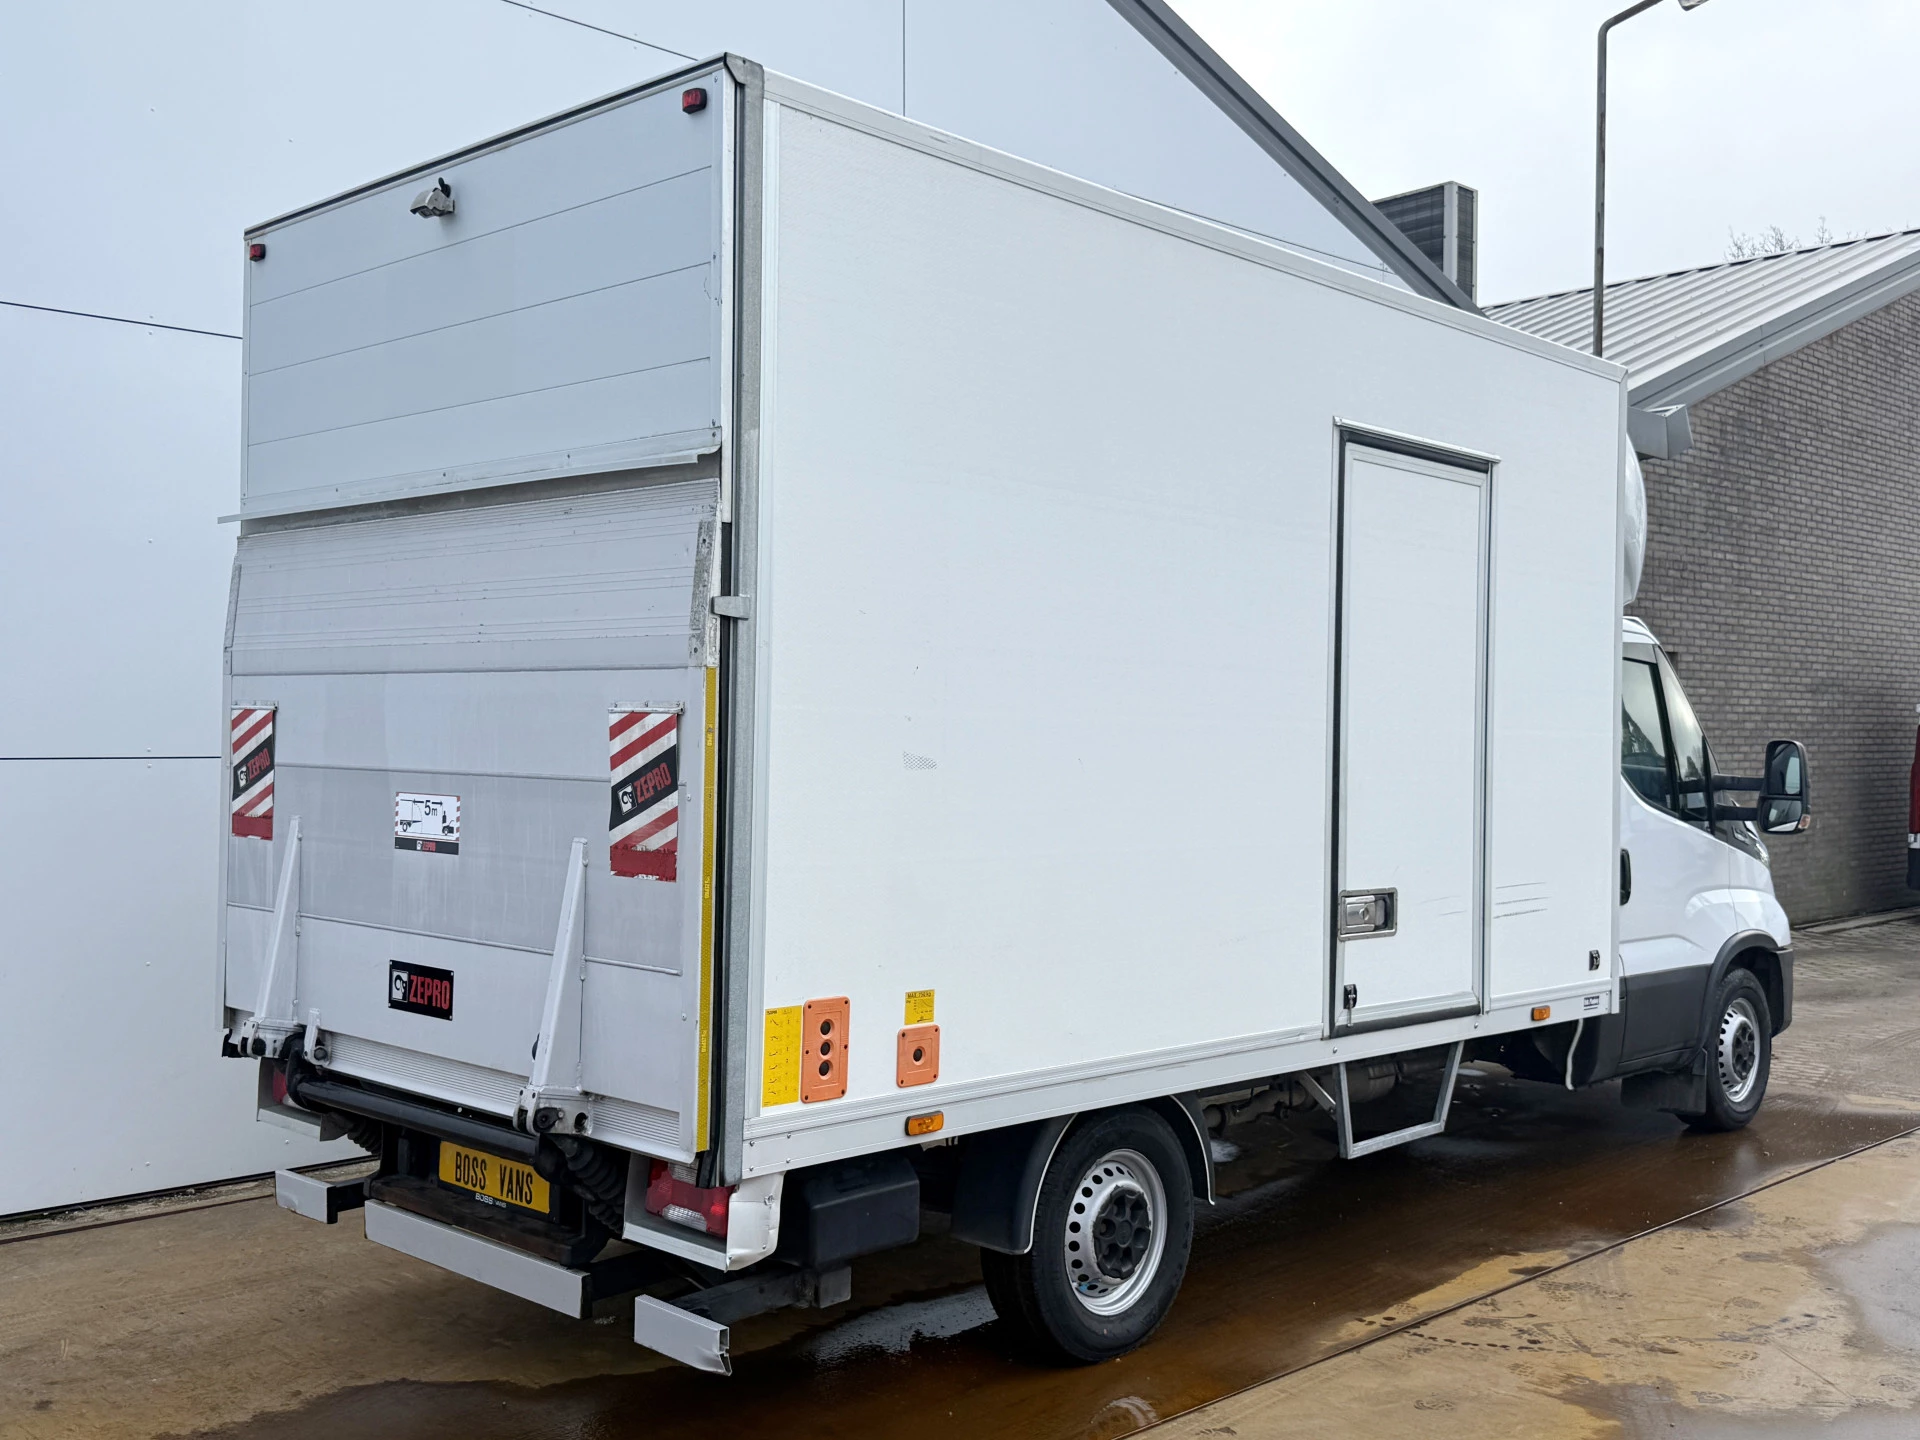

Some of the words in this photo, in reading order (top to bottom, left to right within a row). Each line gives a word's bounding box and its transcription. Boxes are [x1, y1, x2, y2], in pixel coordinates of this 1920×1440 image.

[247, 747, 271, 780] ZEPRO
[633, 762, 672, 804] ZEPRO
[409, 974, 451, 1010] ZEPRO
[455, 1151, 487, 1191] BOSS
[499, 1164, 533, 1205] VANS
[475, 1192, 494, 1205] BOSS
